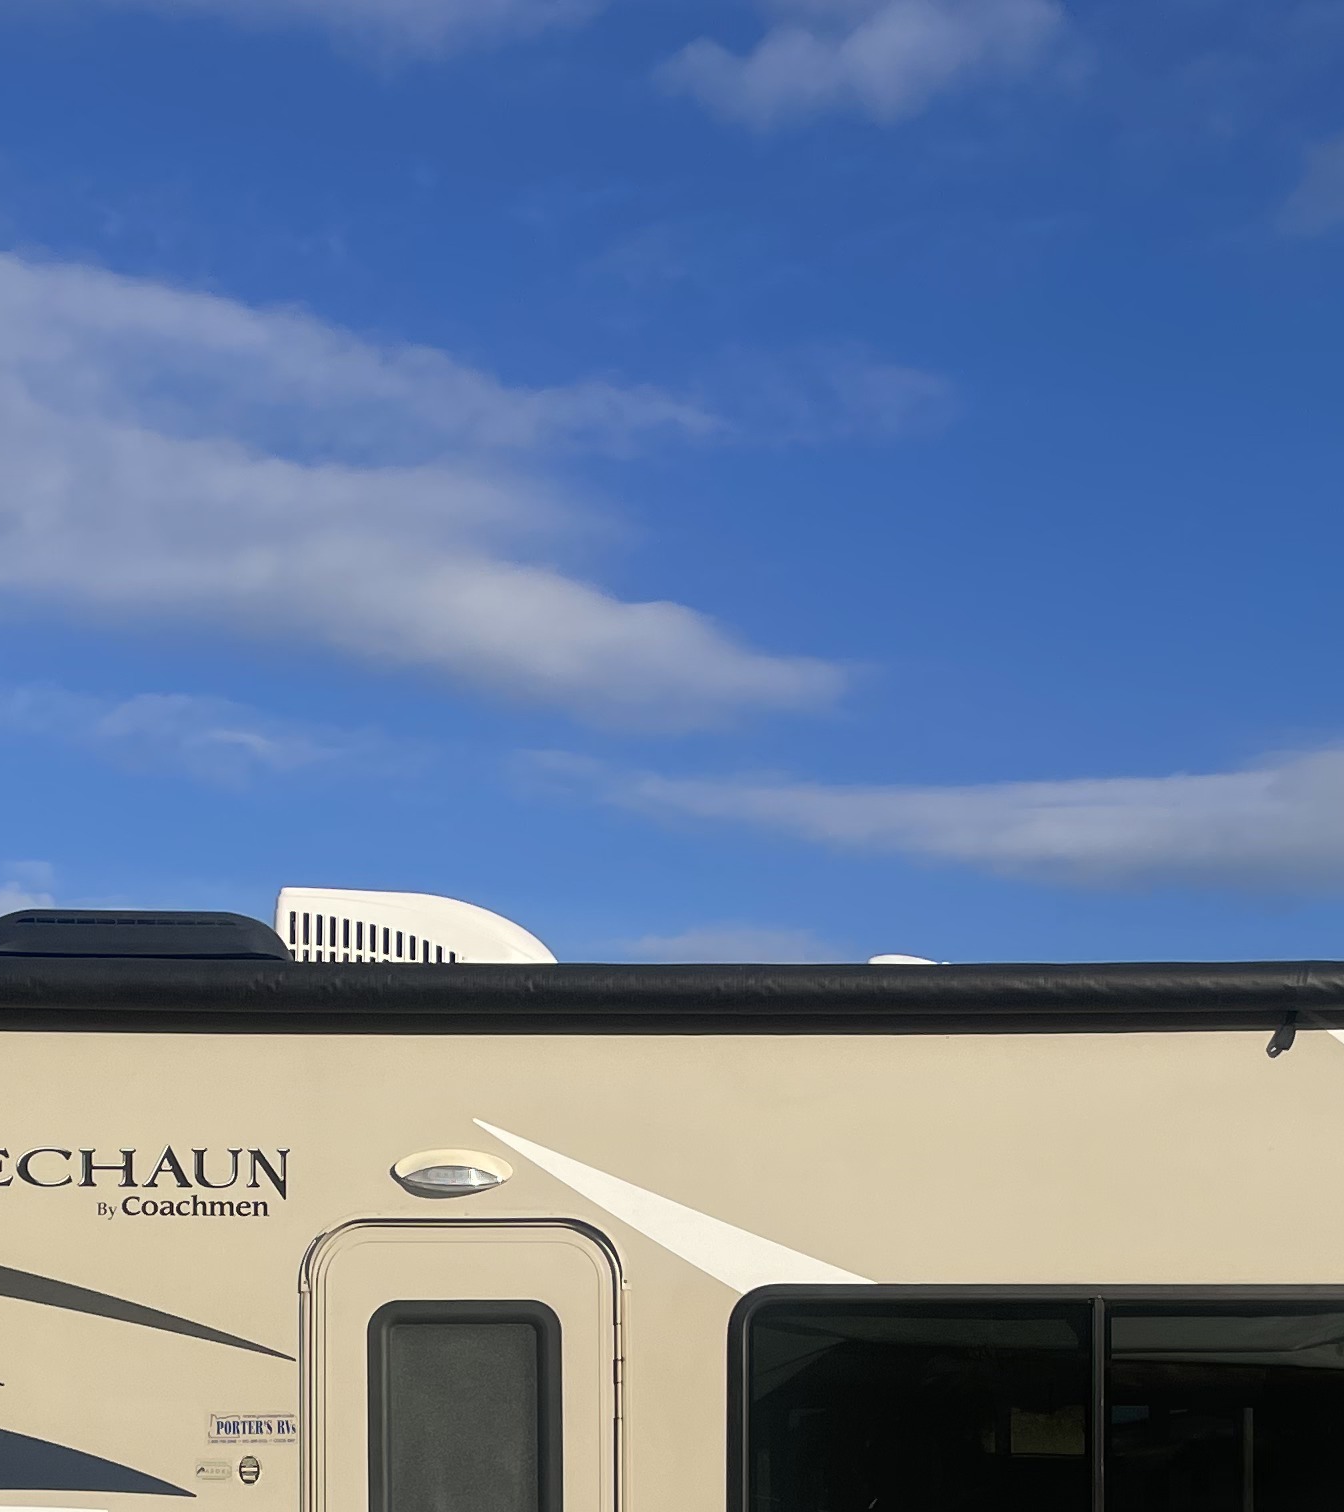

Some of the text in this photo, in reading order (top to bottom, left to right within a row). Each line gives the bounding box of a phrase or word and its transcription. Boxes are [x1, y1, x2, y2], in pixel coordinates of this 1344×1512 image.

[96, 1196, 270, 1220] By Coachmen
[216, 1419, 297, 1435] PORTER'S RVs
